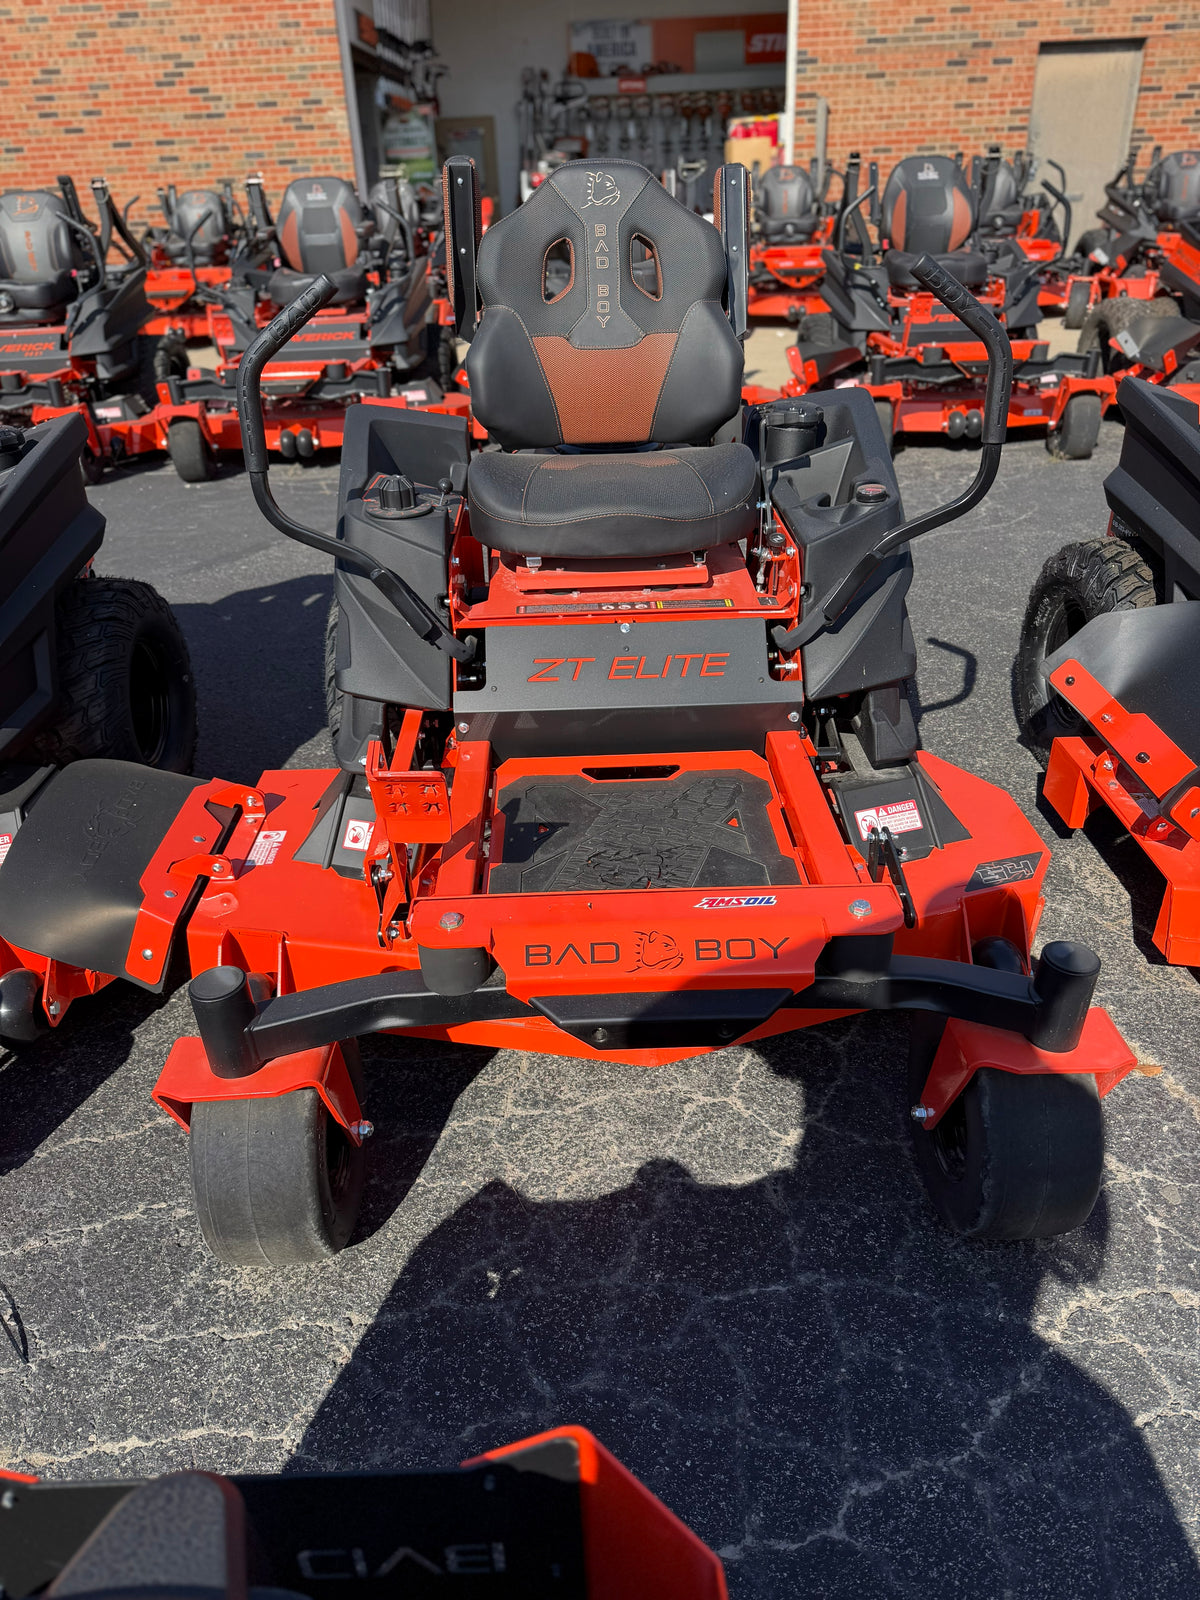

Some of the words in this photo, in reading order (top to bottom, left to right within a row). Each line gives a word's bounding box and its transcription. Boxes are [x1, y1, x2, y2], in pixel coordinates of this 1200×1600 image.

[594, 223, 610, 269] BAD
[596, 284, 611, 329] BOY
[527, 657, 596, 682] ZT
[608, 652, 730, 680] ELITE
[887, 802, 915, 814] DANGER
[695, 896, 777, 909] AMSOIL
[524, 942, 620, 967] BAD
[694, 936, 790, 961] BOY
